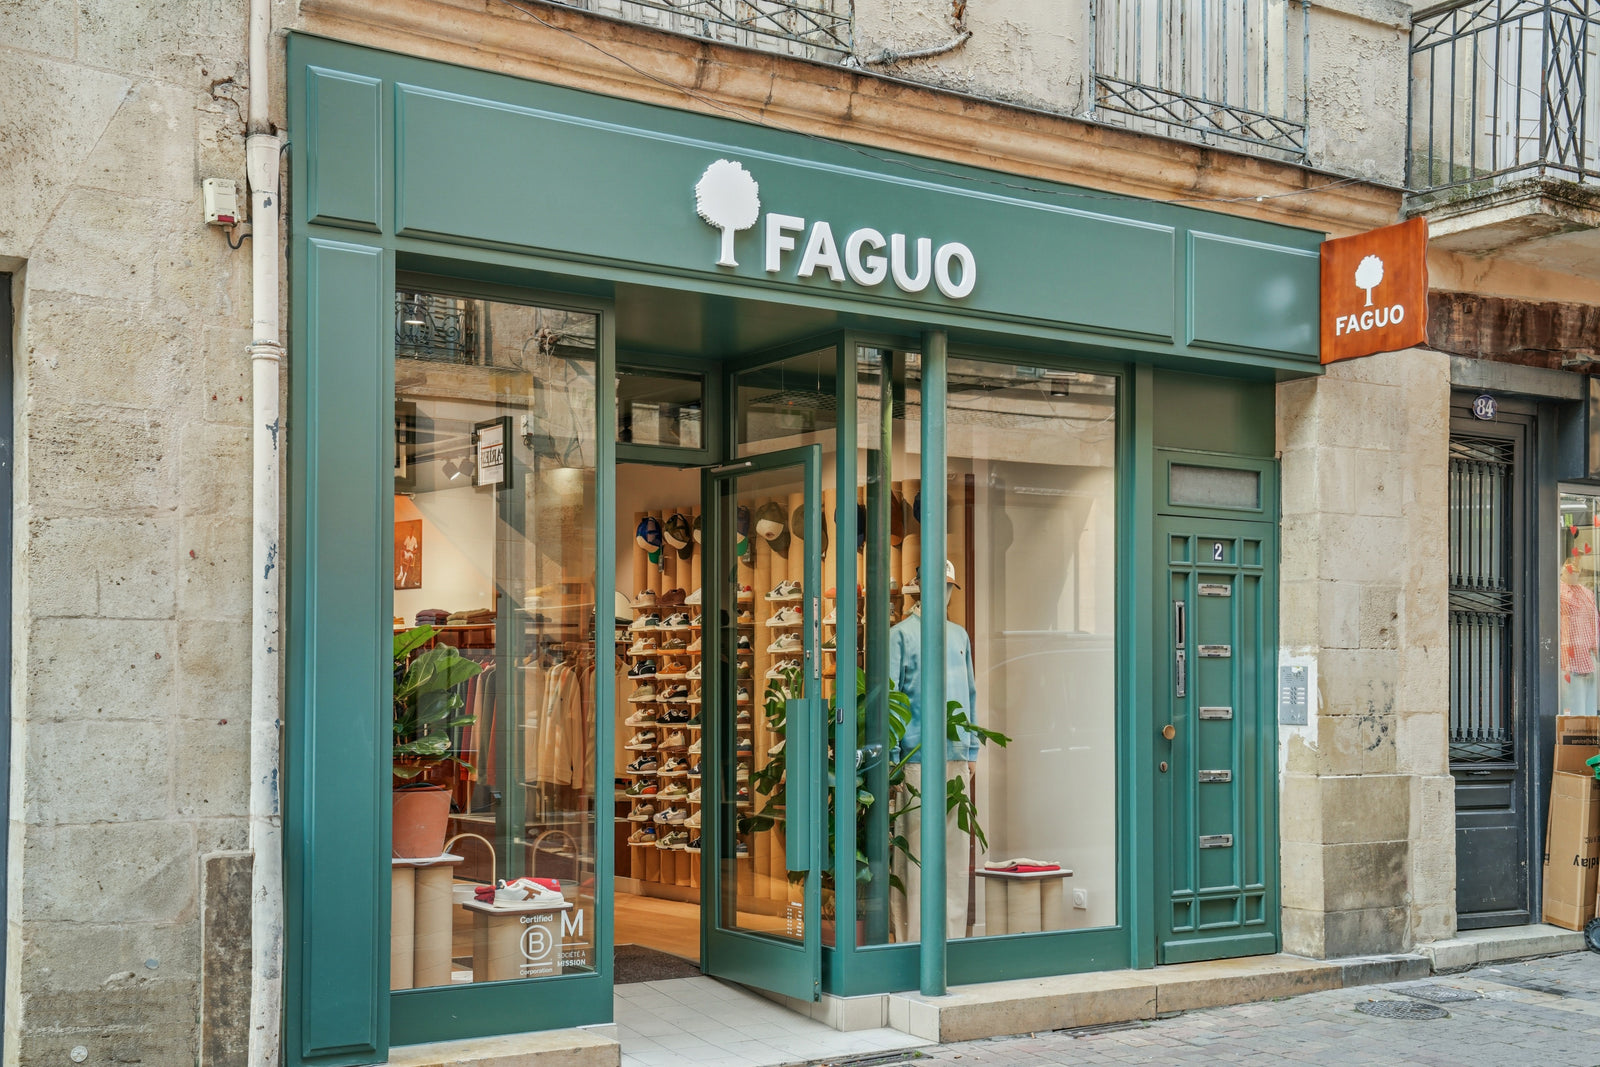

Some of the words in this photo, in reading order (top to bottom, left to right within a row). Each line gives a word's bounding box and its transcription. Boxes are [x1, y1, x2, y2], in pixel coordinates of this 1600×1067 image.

[766, 212, 976, 299] FAGUO
[1335, 304, 1405, 336] FAGUO
[1476, 398, 1494, 417] 84
[1214, 543, 1222, 560] 2
[519, 914, 553, 924] Certified
[560, 908, 584, 938] M
[529, 932, 545, 954] B
[556, 959, 586, 967] MISSION
[557, 950, 580, 959] SOCIÉTÉ
[519, 967, 553, 976] Corporation
